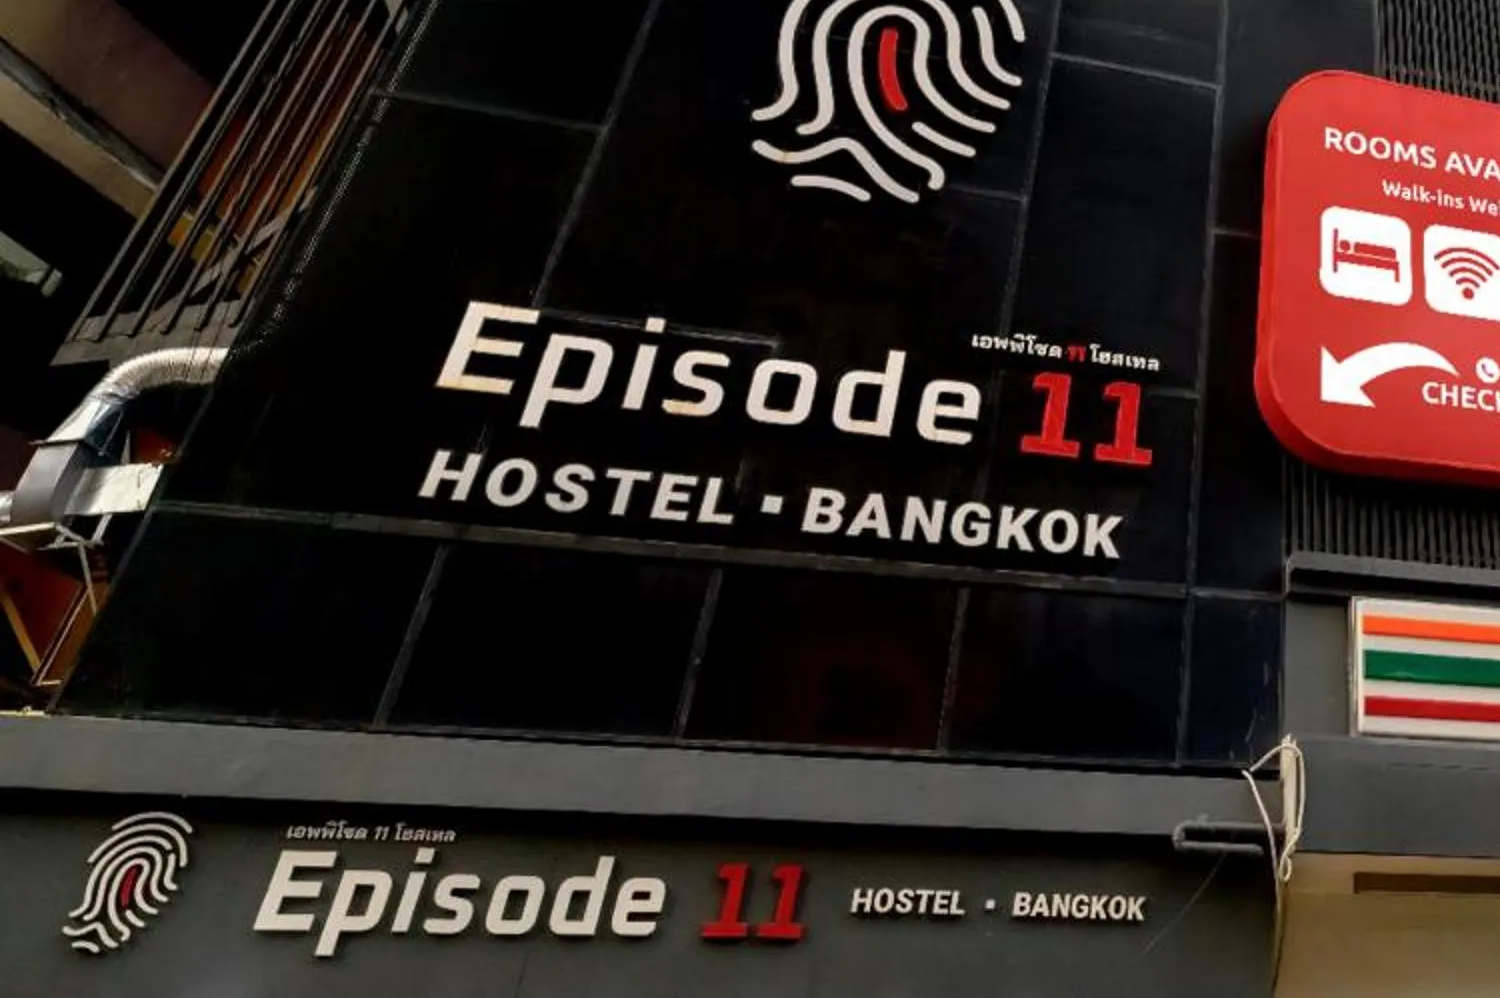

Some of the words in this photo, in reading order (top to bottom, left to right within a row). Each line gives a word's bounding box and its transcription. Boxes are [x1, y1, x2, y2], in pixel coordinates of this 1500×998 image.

[1324, 127, 1437, 169] ROOMS
[1382, 179, 1464, 210] Walk-ins
[436, 300, 981, 445] Episode
[1020, 372, 1153, 467] 11
[1089, 343, 1161, 372] โฮสเทล
[418, 449, 735, 525] HOSTEL
[801, 487, 1124, 559] BANGKOK
[252, 847, 667, 956] Episode
[701, 863, 805, 939] 11
[850, 887, 965, 916] HOSTEL
[1012, 891, 1147, 922] BANGKOK
